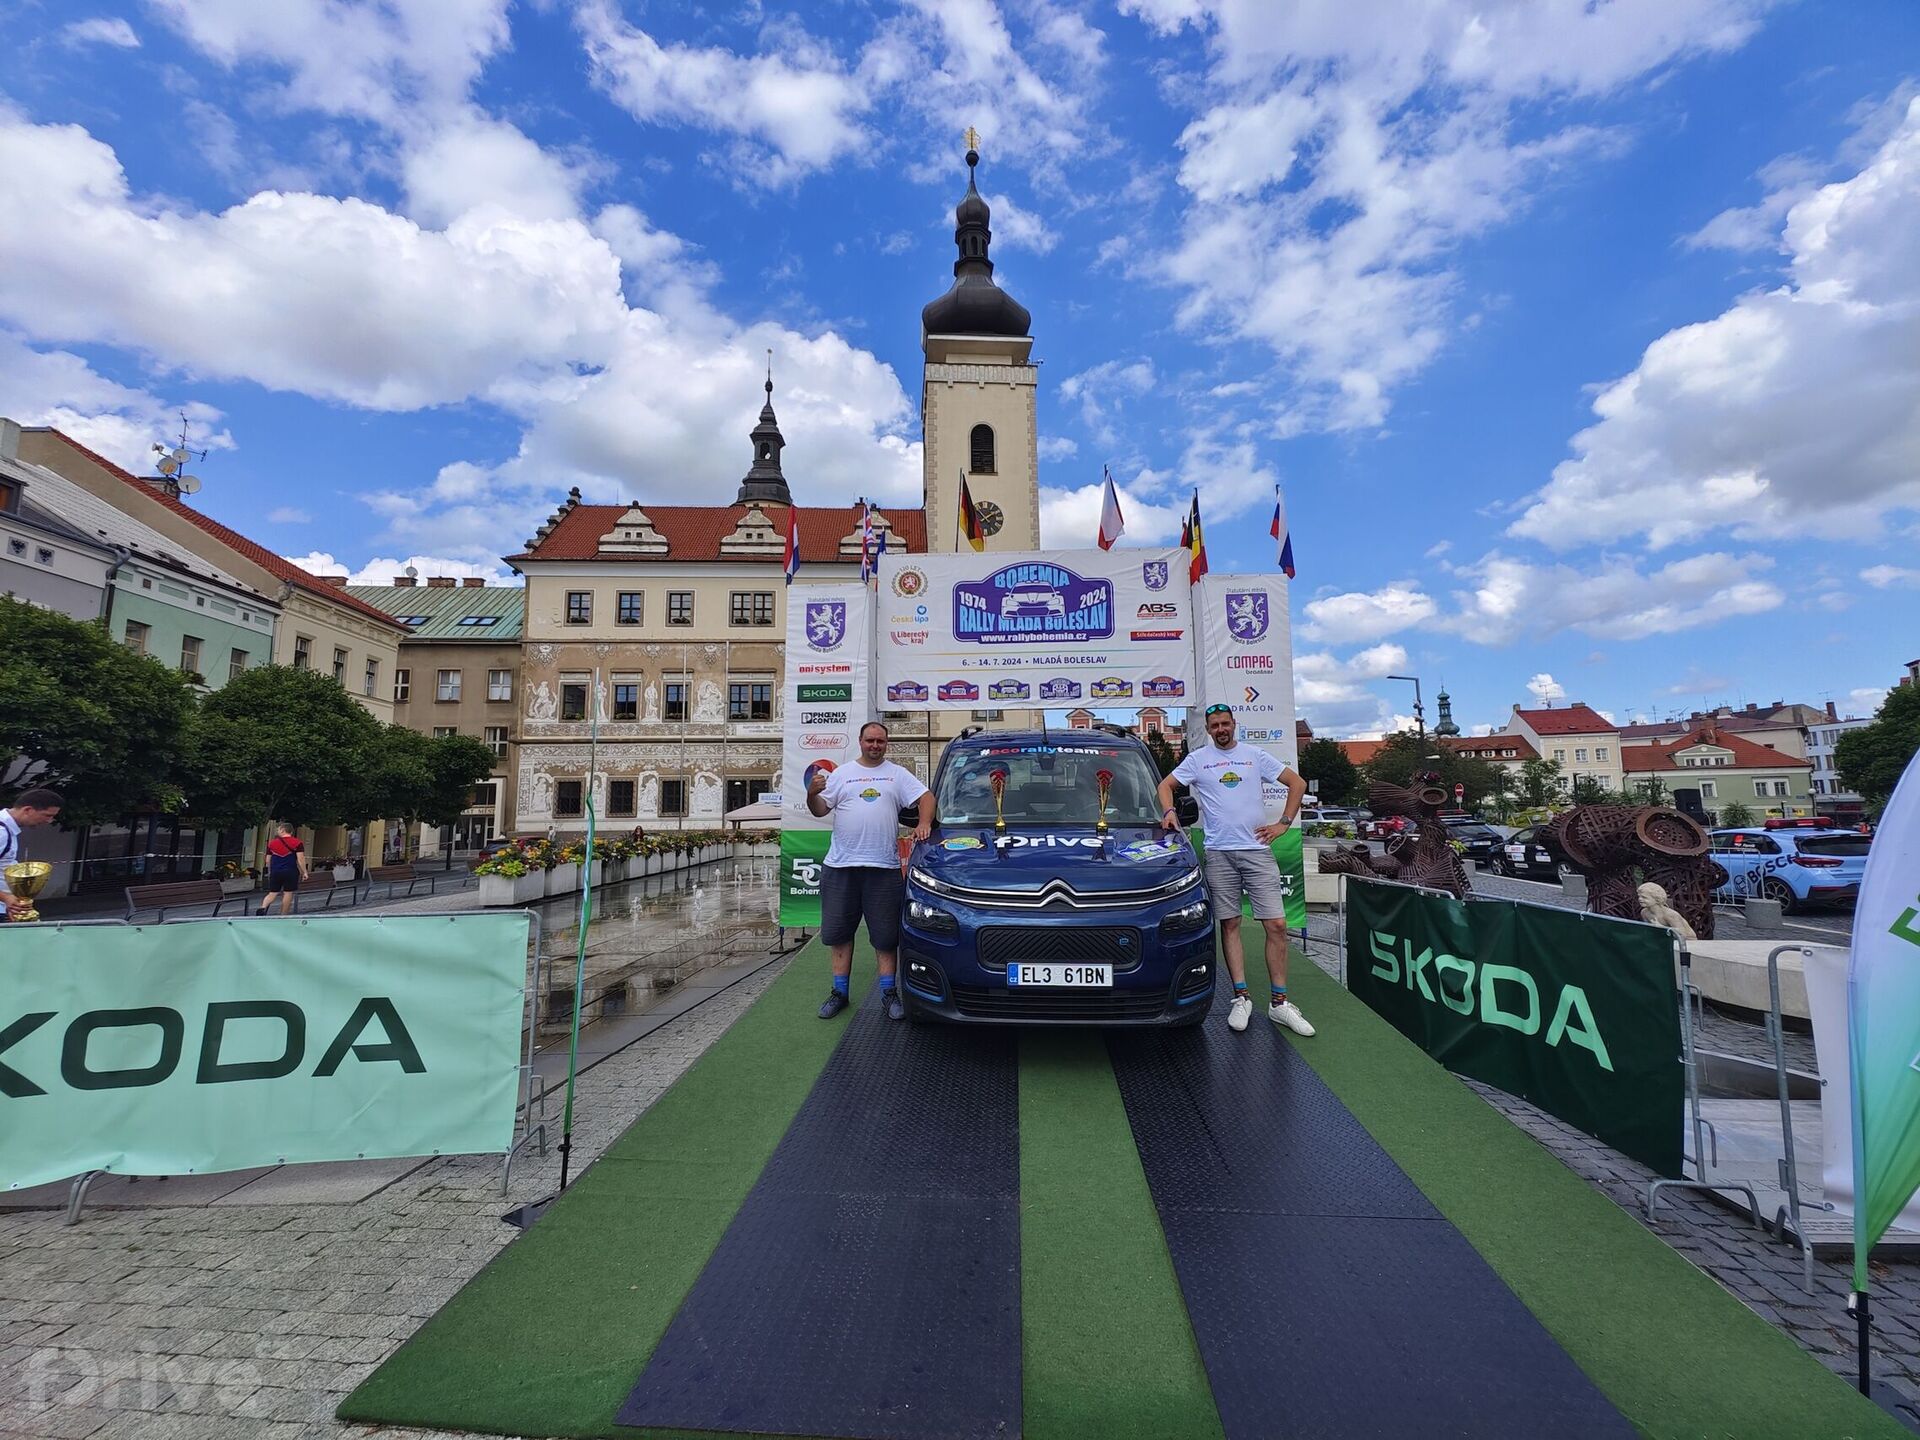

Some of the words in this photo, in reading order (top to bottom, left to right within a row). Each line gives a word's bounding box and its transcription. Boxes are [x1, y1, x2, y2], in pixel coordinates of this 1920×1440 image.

[995, 565, 1070, 588] BOHEMIA
[958, 591, 987, 610] 1974
[1079, 586, 1107, 608] 2024
[959, 604, 995, 632] RALLY
[1045, 602, 1107, 630] BOLESLAV
[1137, 603, 1177, 613] ABS
[980, 633, 1087, 643] www.rallybohemia.cz
[962, 658, 970, 666] 6.
[978, 658, 991, 666] 14.
[993, 658, 1000, 666] 7.
[1001, 657, 1022, 665] 2024
[1032, 655, 1062, 665] MLADÁ
[1063, 656, 1107, 664] BOLESLAV
[1227, 655, 1273, 669] COMPAG
[1746, 851, 1800, 884] BOSCH
[1021, 967, 1052, 983] EL3
[1064, 967, 1105, 984] 61BN
